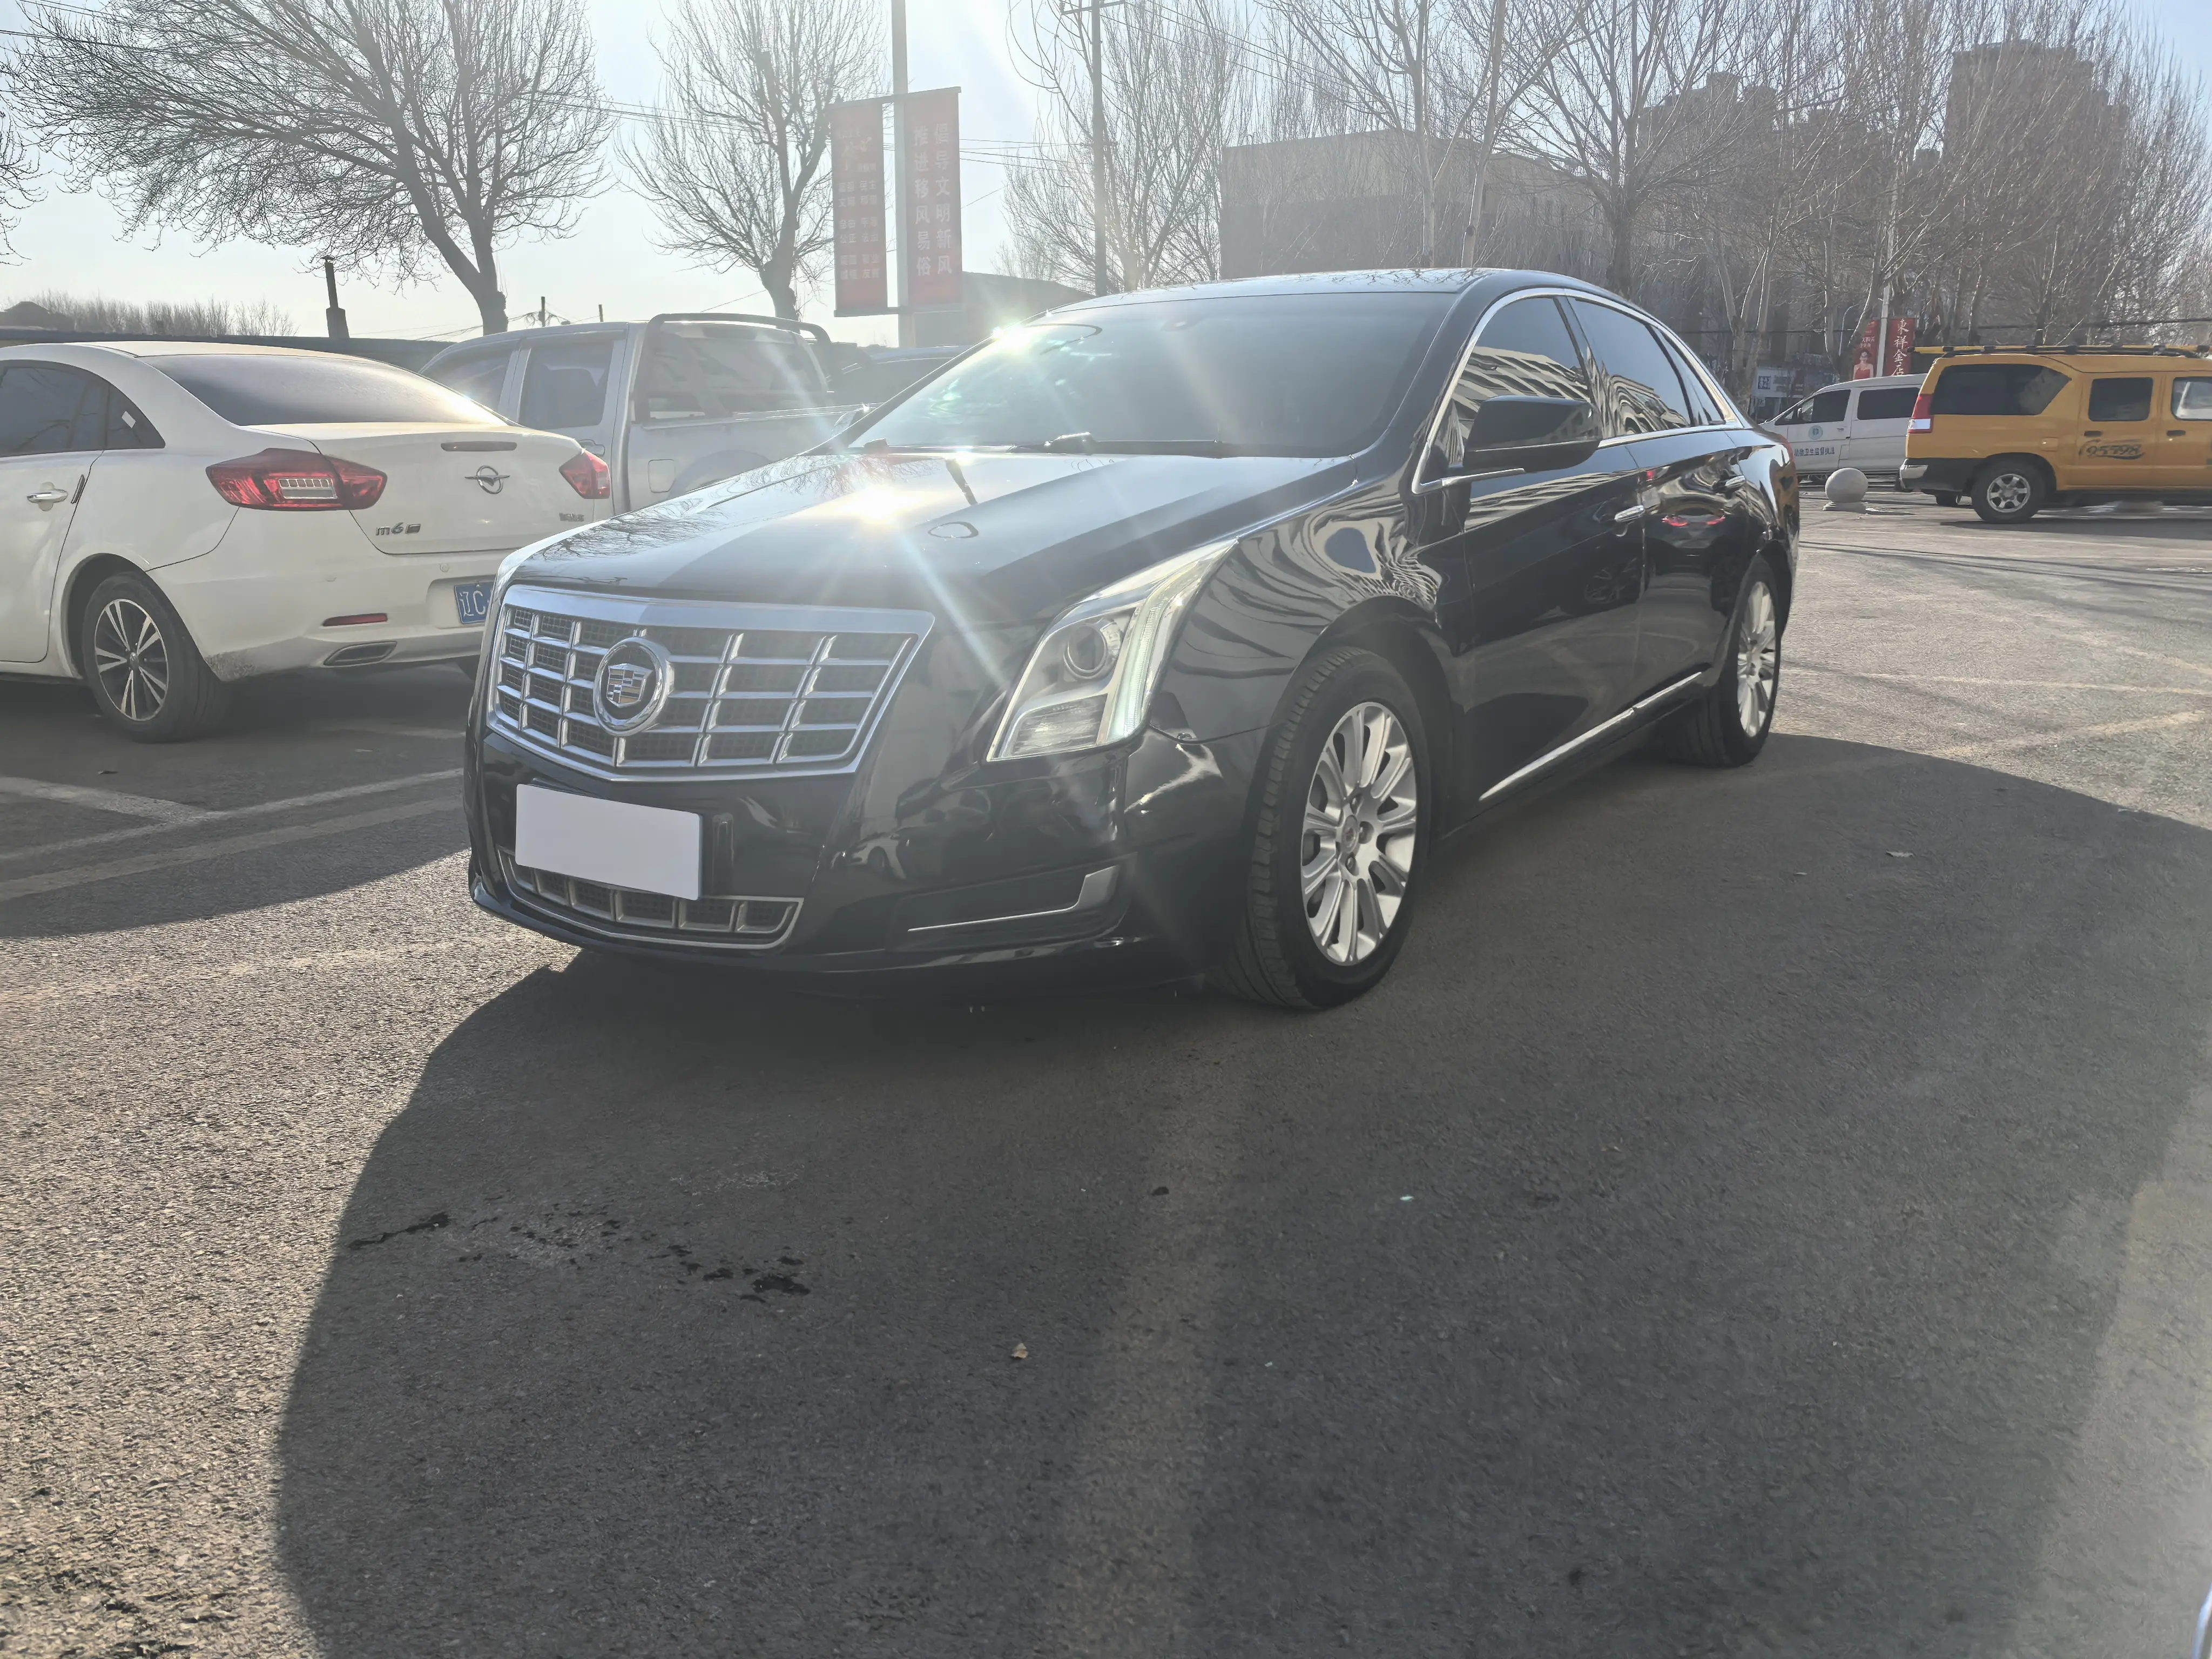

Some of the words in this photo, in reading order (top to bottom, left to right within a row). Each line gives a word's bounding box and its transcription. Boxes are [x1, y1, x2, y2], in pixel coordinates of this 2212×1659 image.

[913, 125, 931, 276] 推进移风易俗
[933, 123, 952, 274] 倡导文明新风
